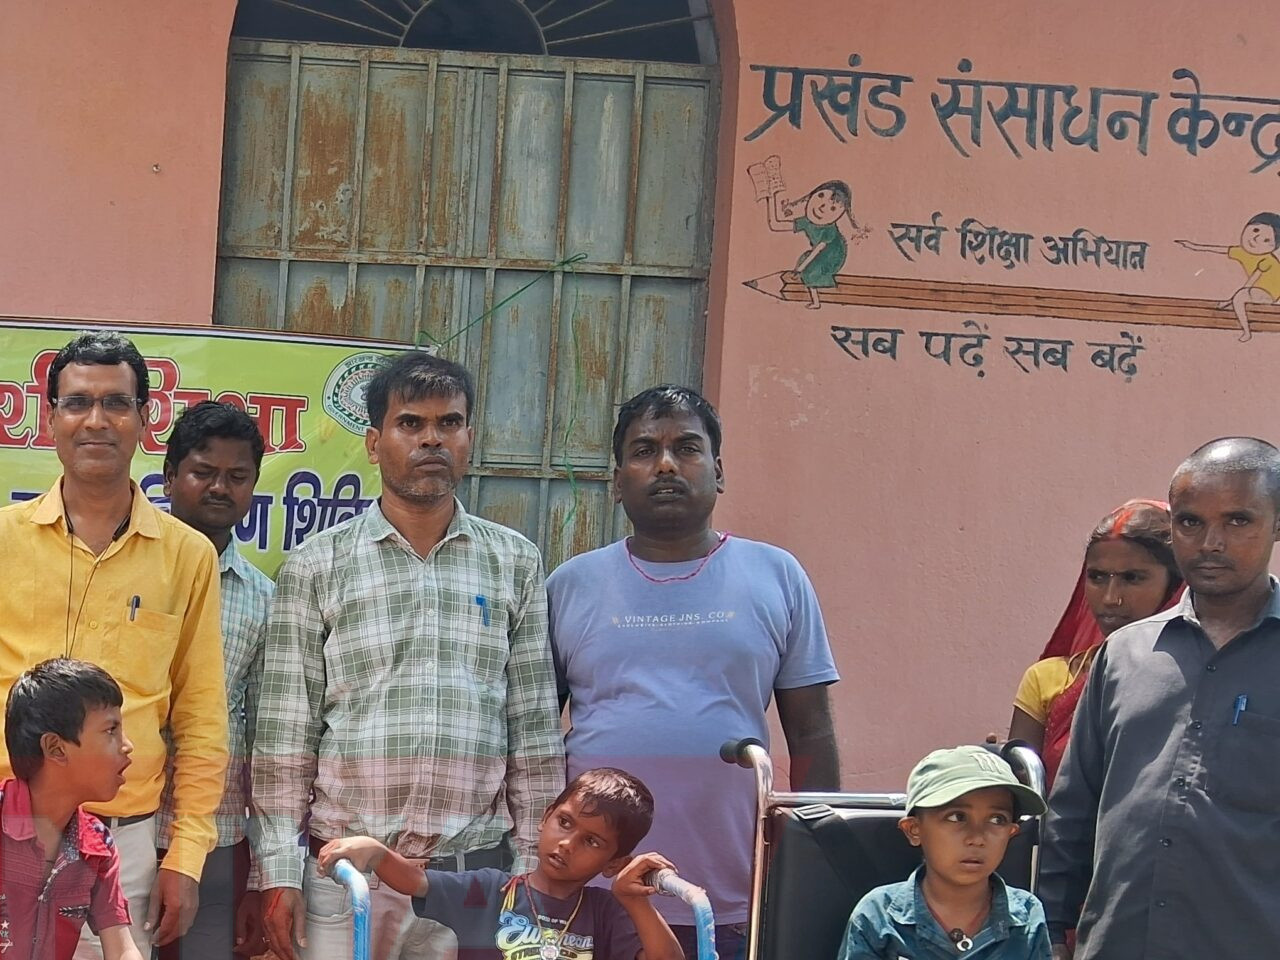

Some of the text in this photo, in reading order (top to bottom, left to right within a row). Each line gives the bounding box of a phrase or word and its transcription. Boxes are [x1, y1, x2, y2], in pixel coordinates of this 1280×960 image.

[744, 54, 914, 143] प्रखंड
[931, 58, 1159, 158] संसाधन
[888, 212, 1149, 270] सर्व शिक्षा अभियान
[831, 326, 904, 360] सब
[1004, 337, 1074, 373] सब
[624, 614, 676, 624] VINTAGE
